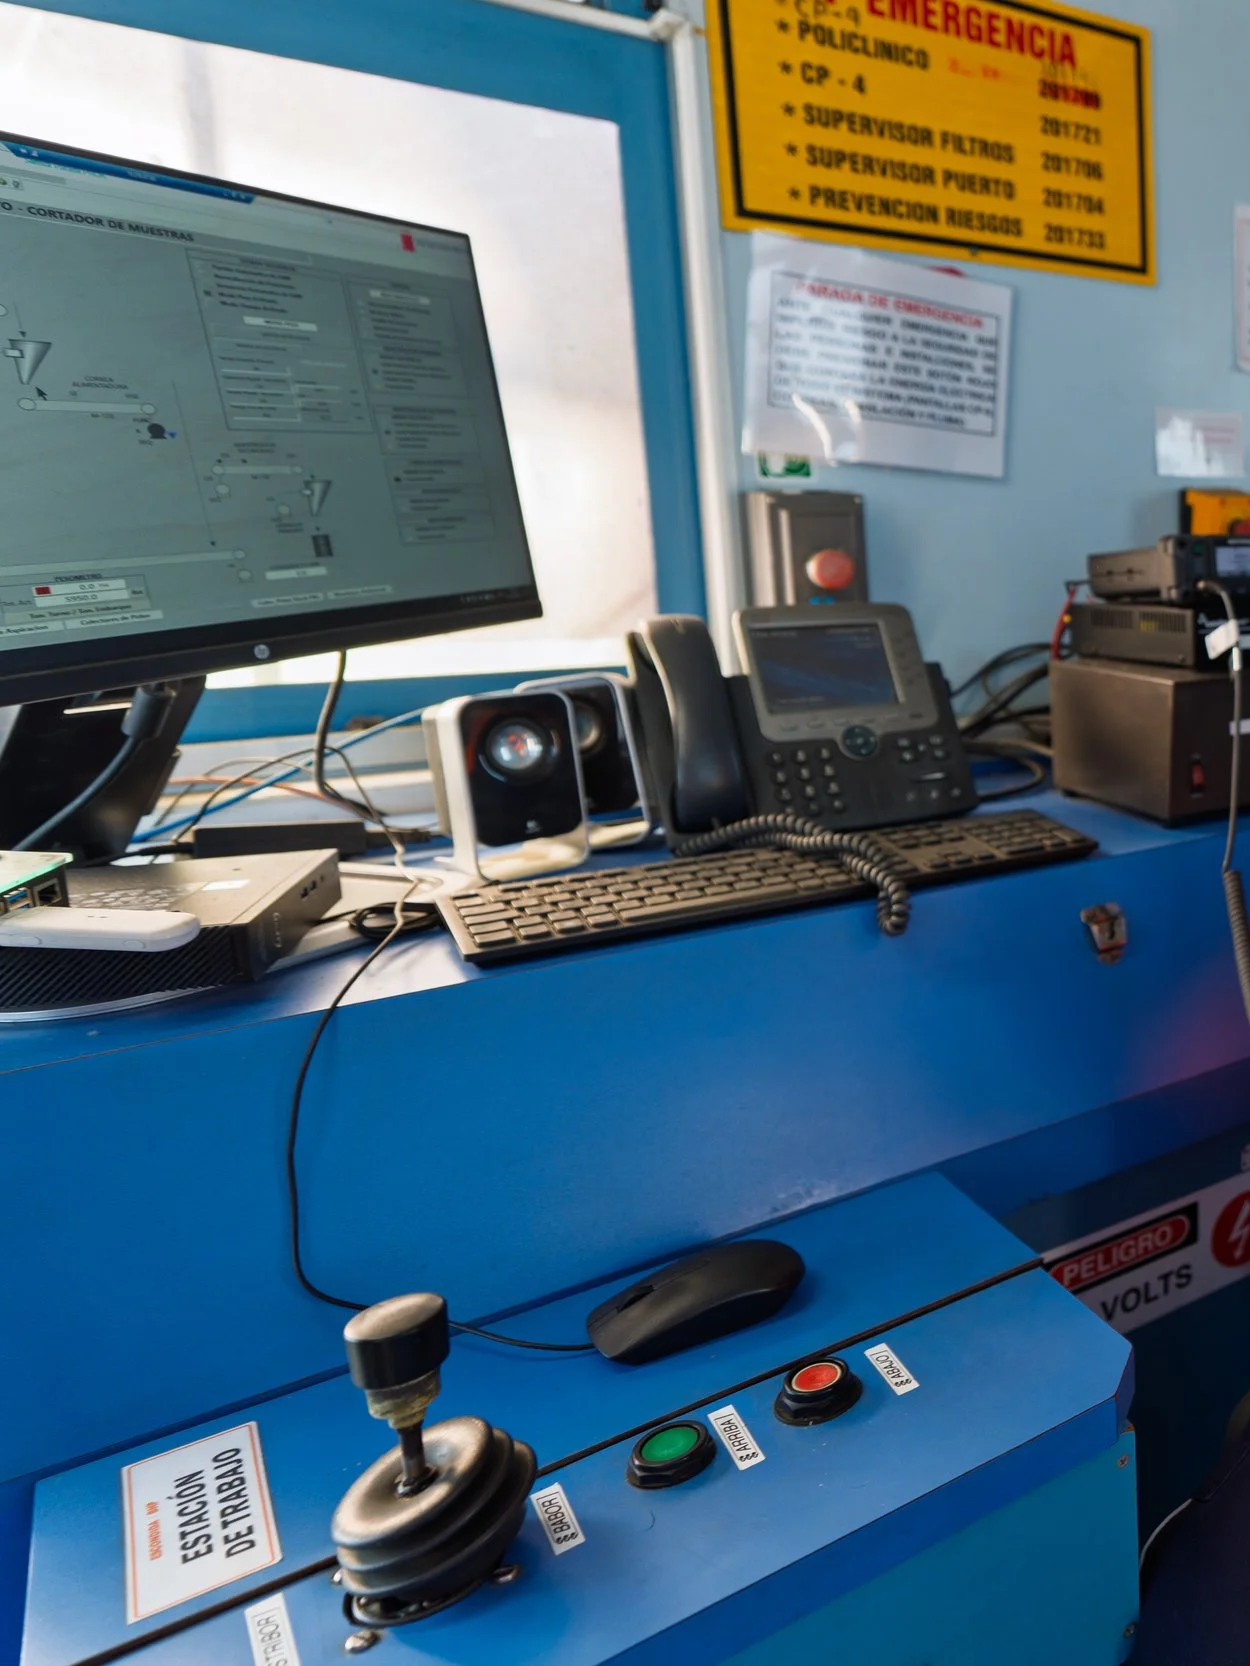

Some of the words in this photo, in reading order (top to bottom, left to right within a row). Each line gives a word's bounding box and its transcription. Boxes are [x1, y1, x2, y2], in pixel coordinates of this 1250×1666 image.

[797, 18, 930, 71] POLICLINICO
[868, 0, 1076, 69] EMERGENCIA
[801, 62, 830, 86] CP
[853, 73, 866, 94] 4
[803, 103, 934, 148] SUPERVISOR
[940, 130, 1016, 164] FILTROS
[805, 145, 936, 186] SUPERVISOR
[942, 168, 1017, 201] PUERTO
[27, 206, 104, 228] CORTADOR
[108, 219, 125, 231] DE
[128, 222, 195, 242] MUESTRAS
[808, 184, 940, 226] PREVENCION
[945, 207, 1023, 237] RIESGOS
[1062, 1225, 1174, 1287] PELIGRO
[1100, 1264, 1193, 1322] VOLTS
[875, 1354, 904, 1379] ABAJO
[720, 1418, 752, 1452] ARRIBA
[211, 1447, 253, 1529] TRABAJO
[167, 1469, 216, 1565] ESTACIÓN
[222, 1524, 257, 1559] DE
[541, 1496, 571, 1534] BABOR
